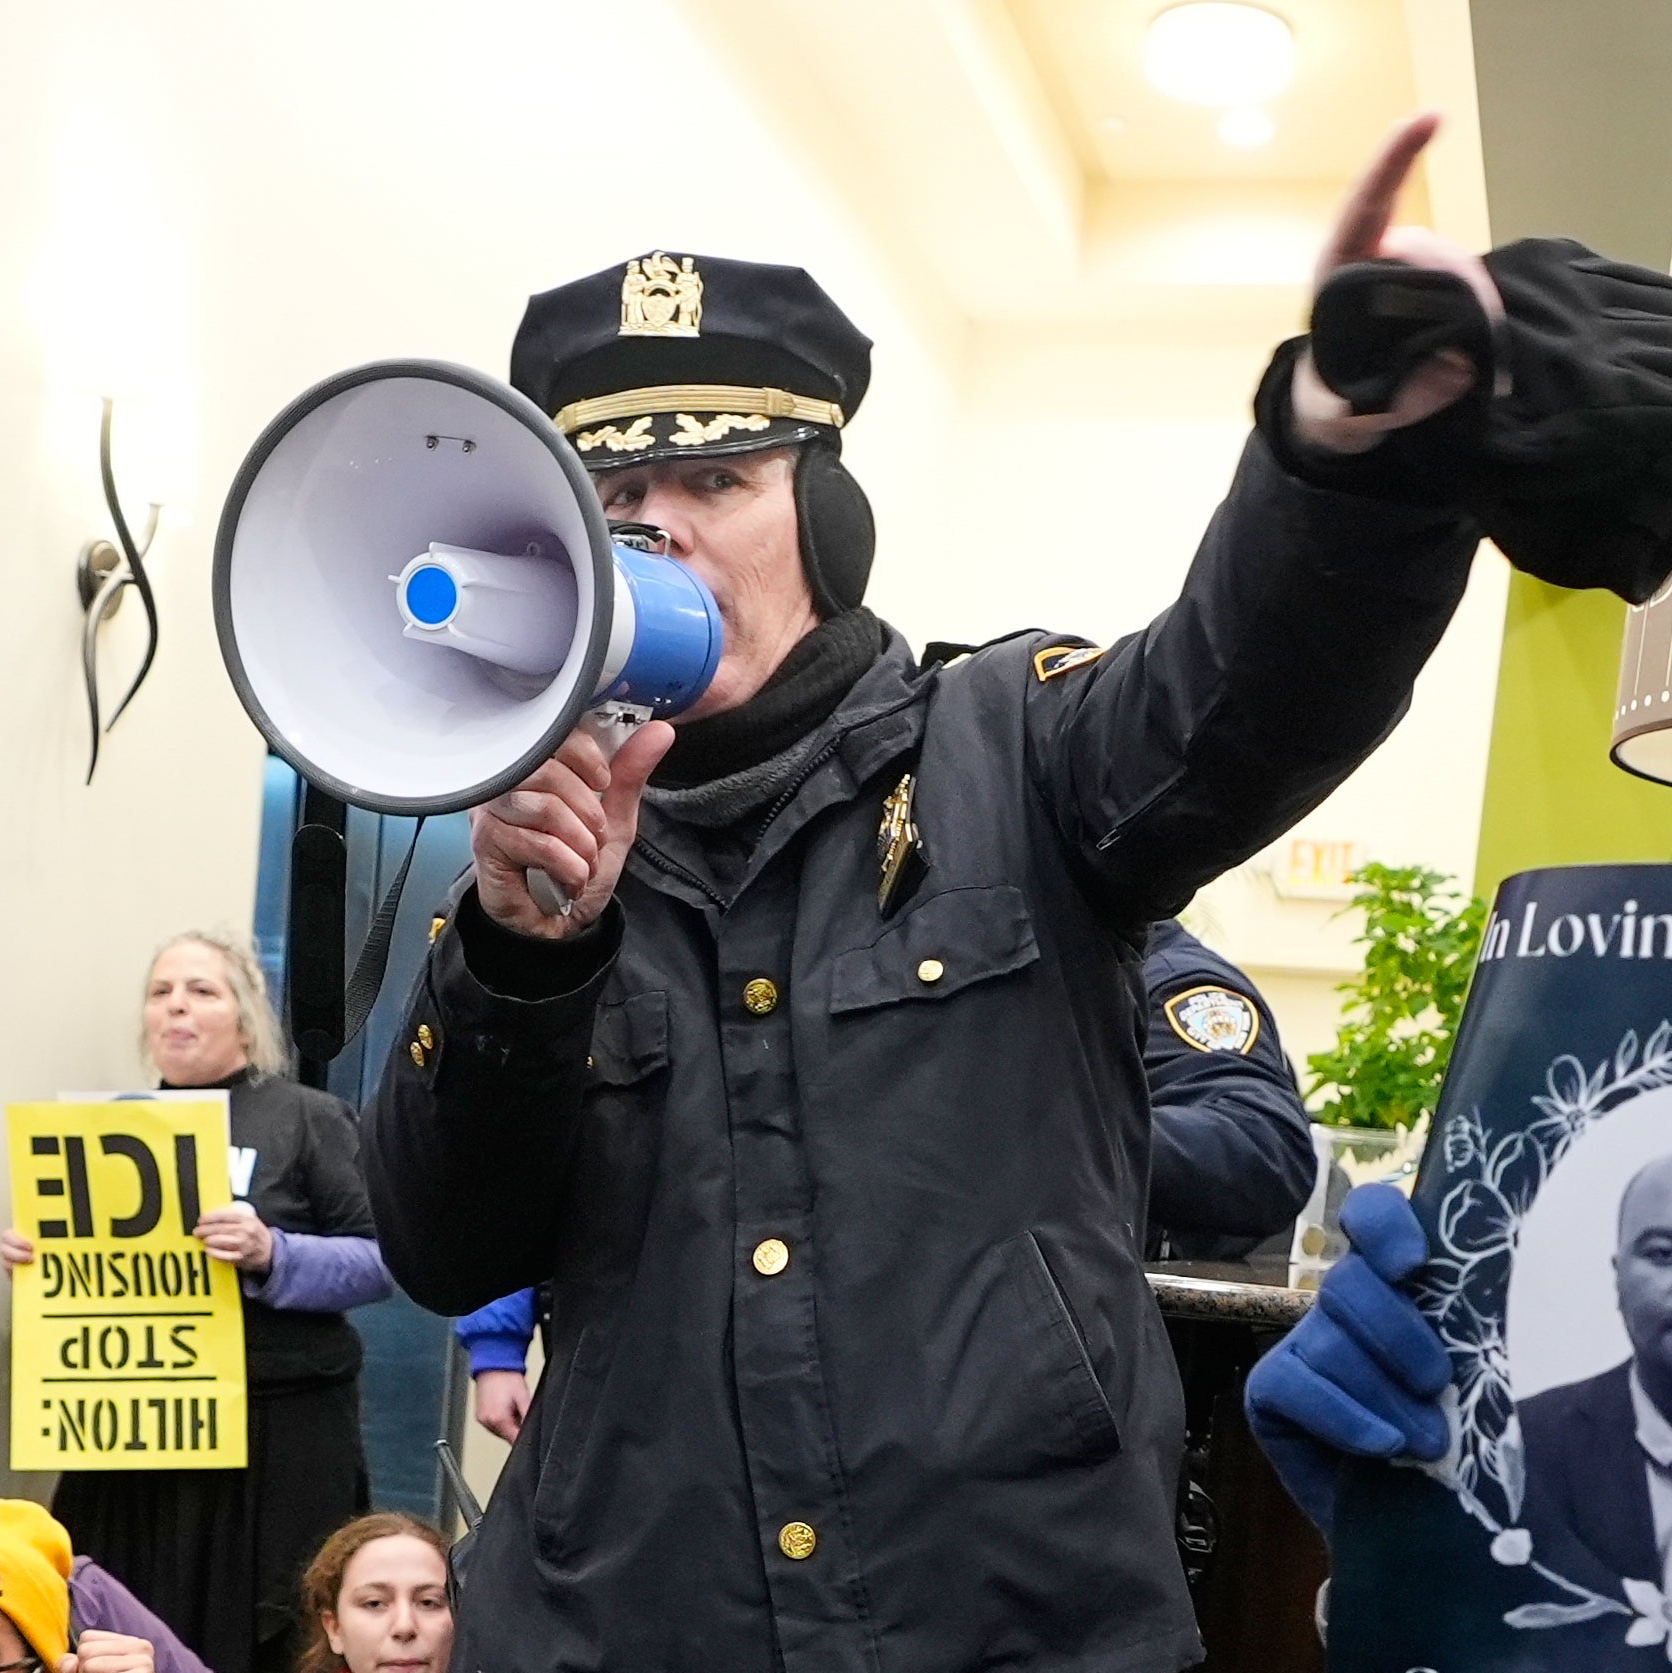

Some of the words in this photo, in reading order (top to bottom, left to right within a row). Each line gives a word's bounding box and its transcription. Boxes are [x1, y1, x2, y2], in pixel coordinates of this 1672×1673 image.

[1288, 838, 1355, 886] EXIT
[30, 1133, 202, 1239] ICE
[41, 1251, 212, 1298] HOUSING
[60, 1324, 198, 1369] STOP
[40, 1397, 218, 1452] HILTON:
